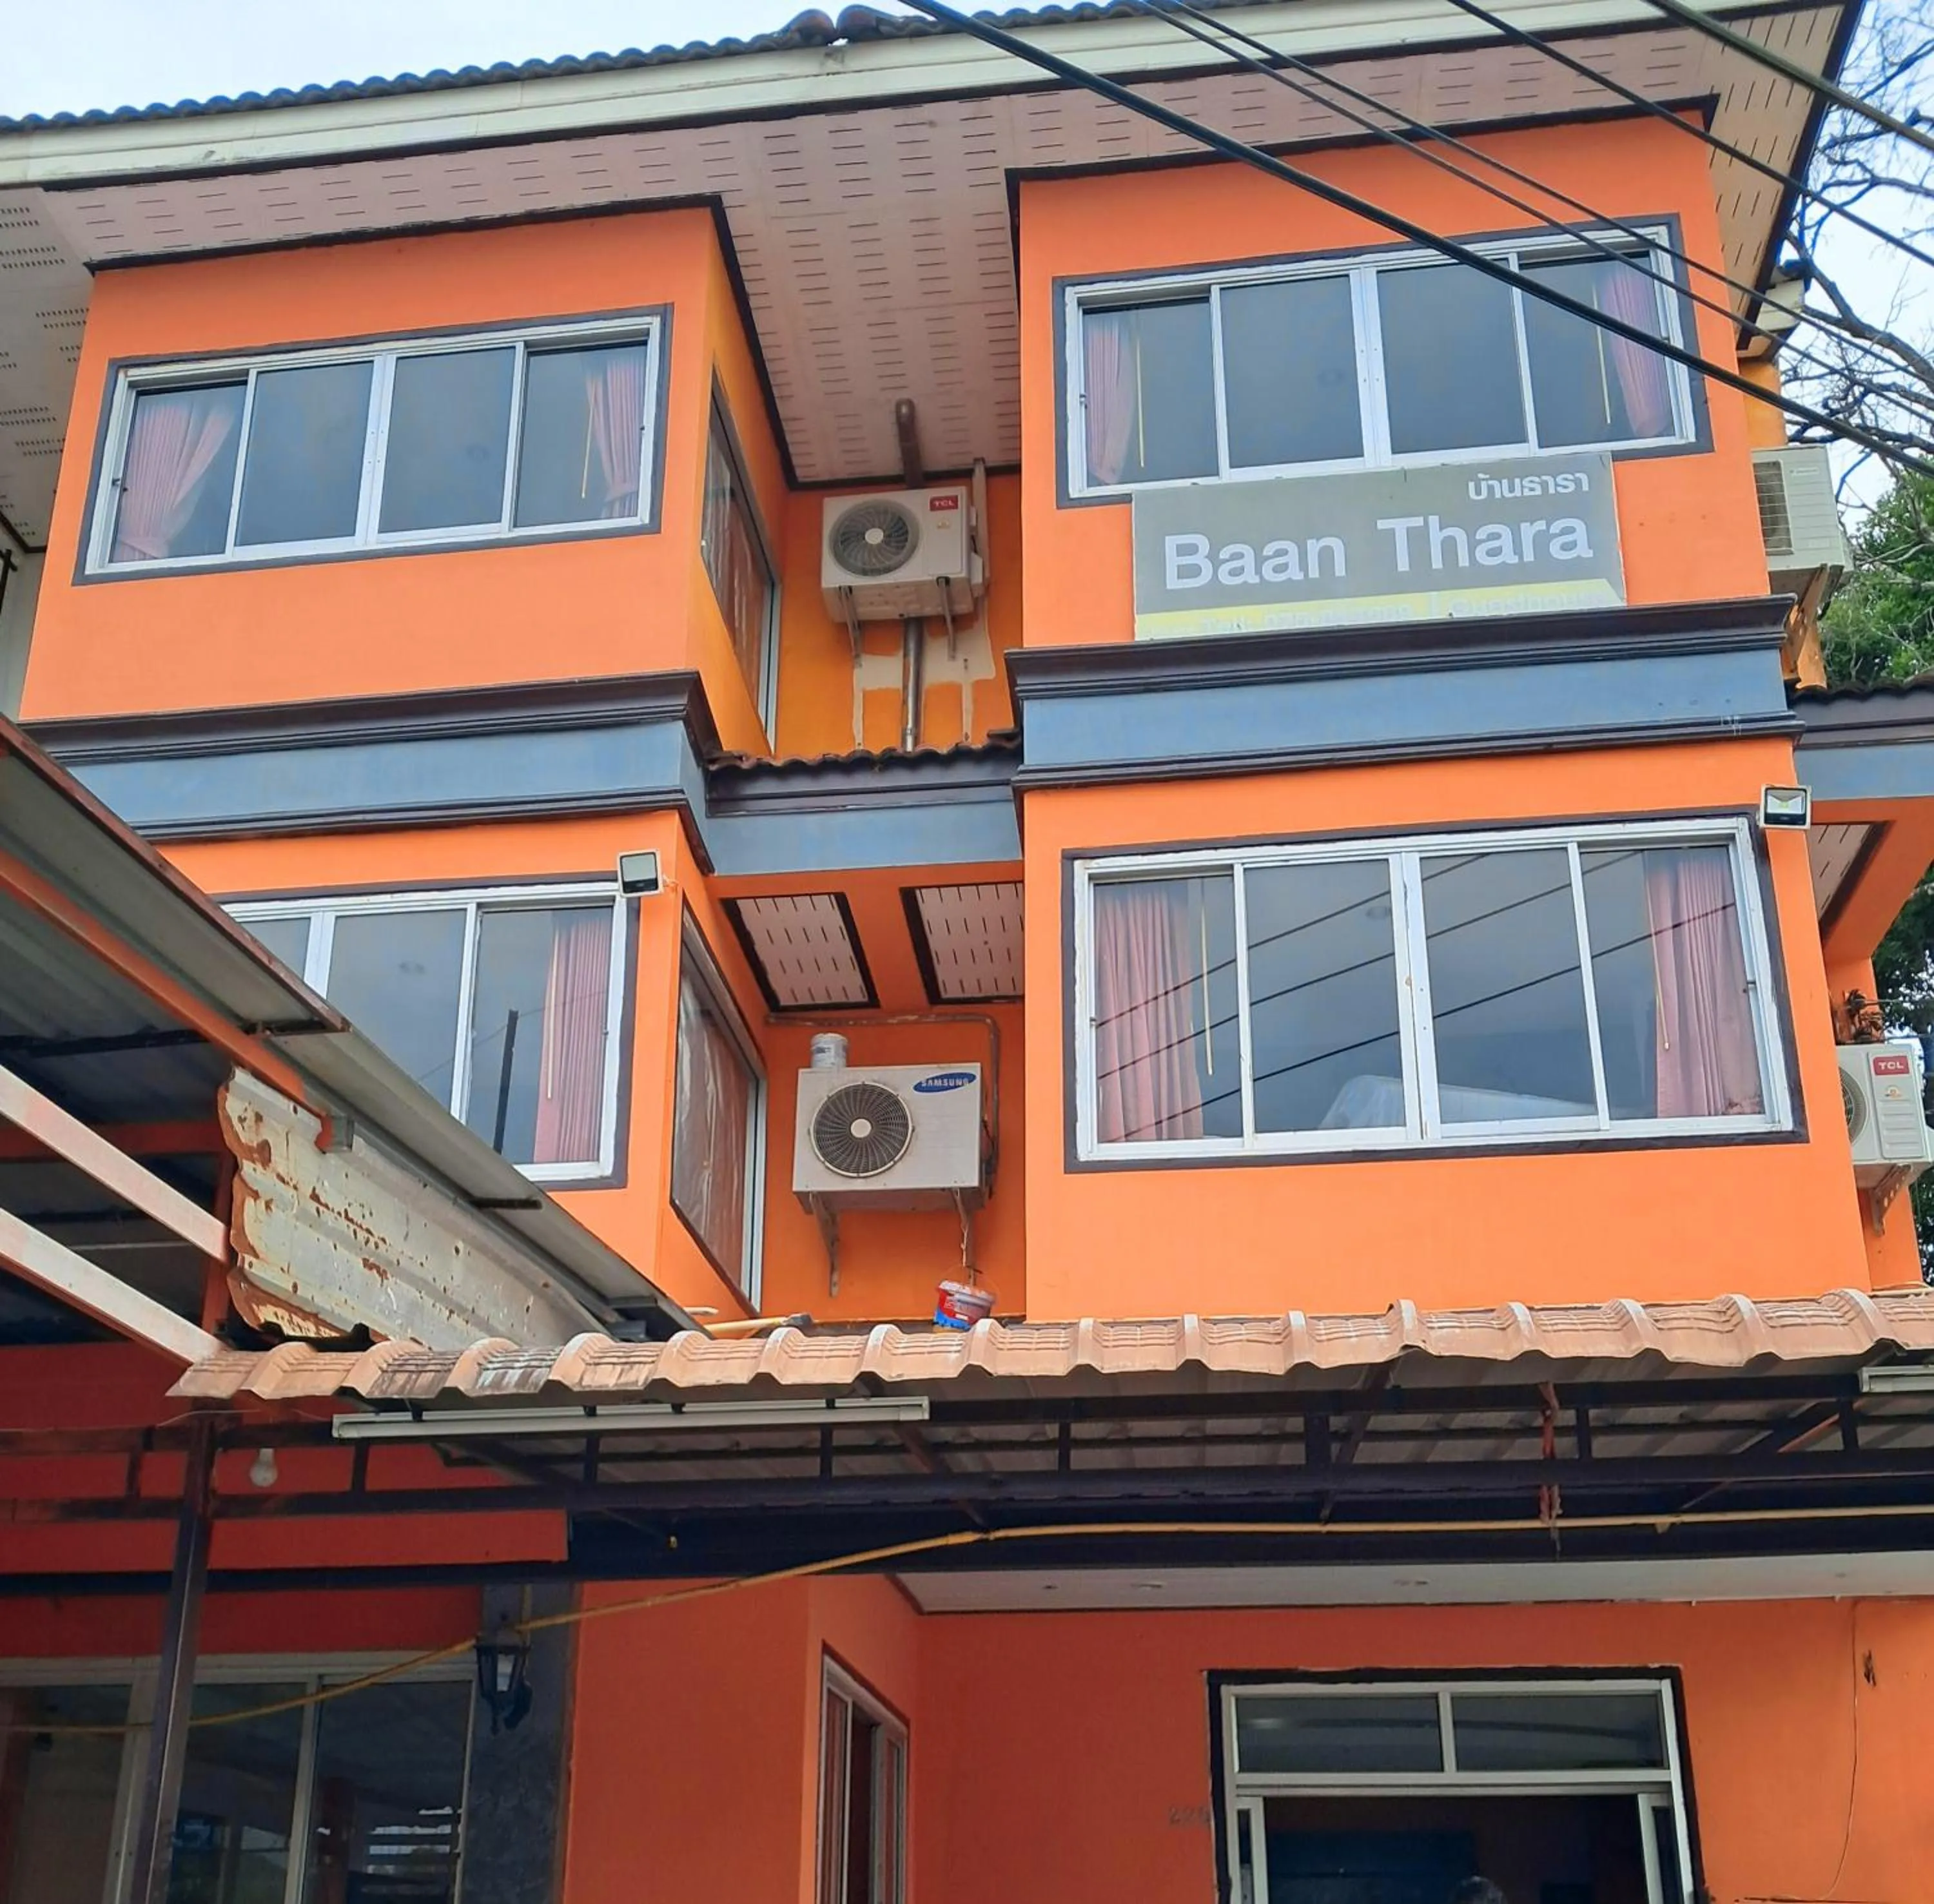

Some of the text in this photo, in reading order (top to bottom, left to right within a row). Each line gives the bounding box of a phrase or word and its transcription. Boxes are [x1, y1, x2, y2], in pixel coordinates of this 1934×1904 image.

[1468, 472, 1589, 500] บ้านธารา
[1164, 515, 1594, 590] Baan Thara
[1878, 1062, 1904, 1070] TCL
[921, 1078, 970, 1087] SAMSUNG
